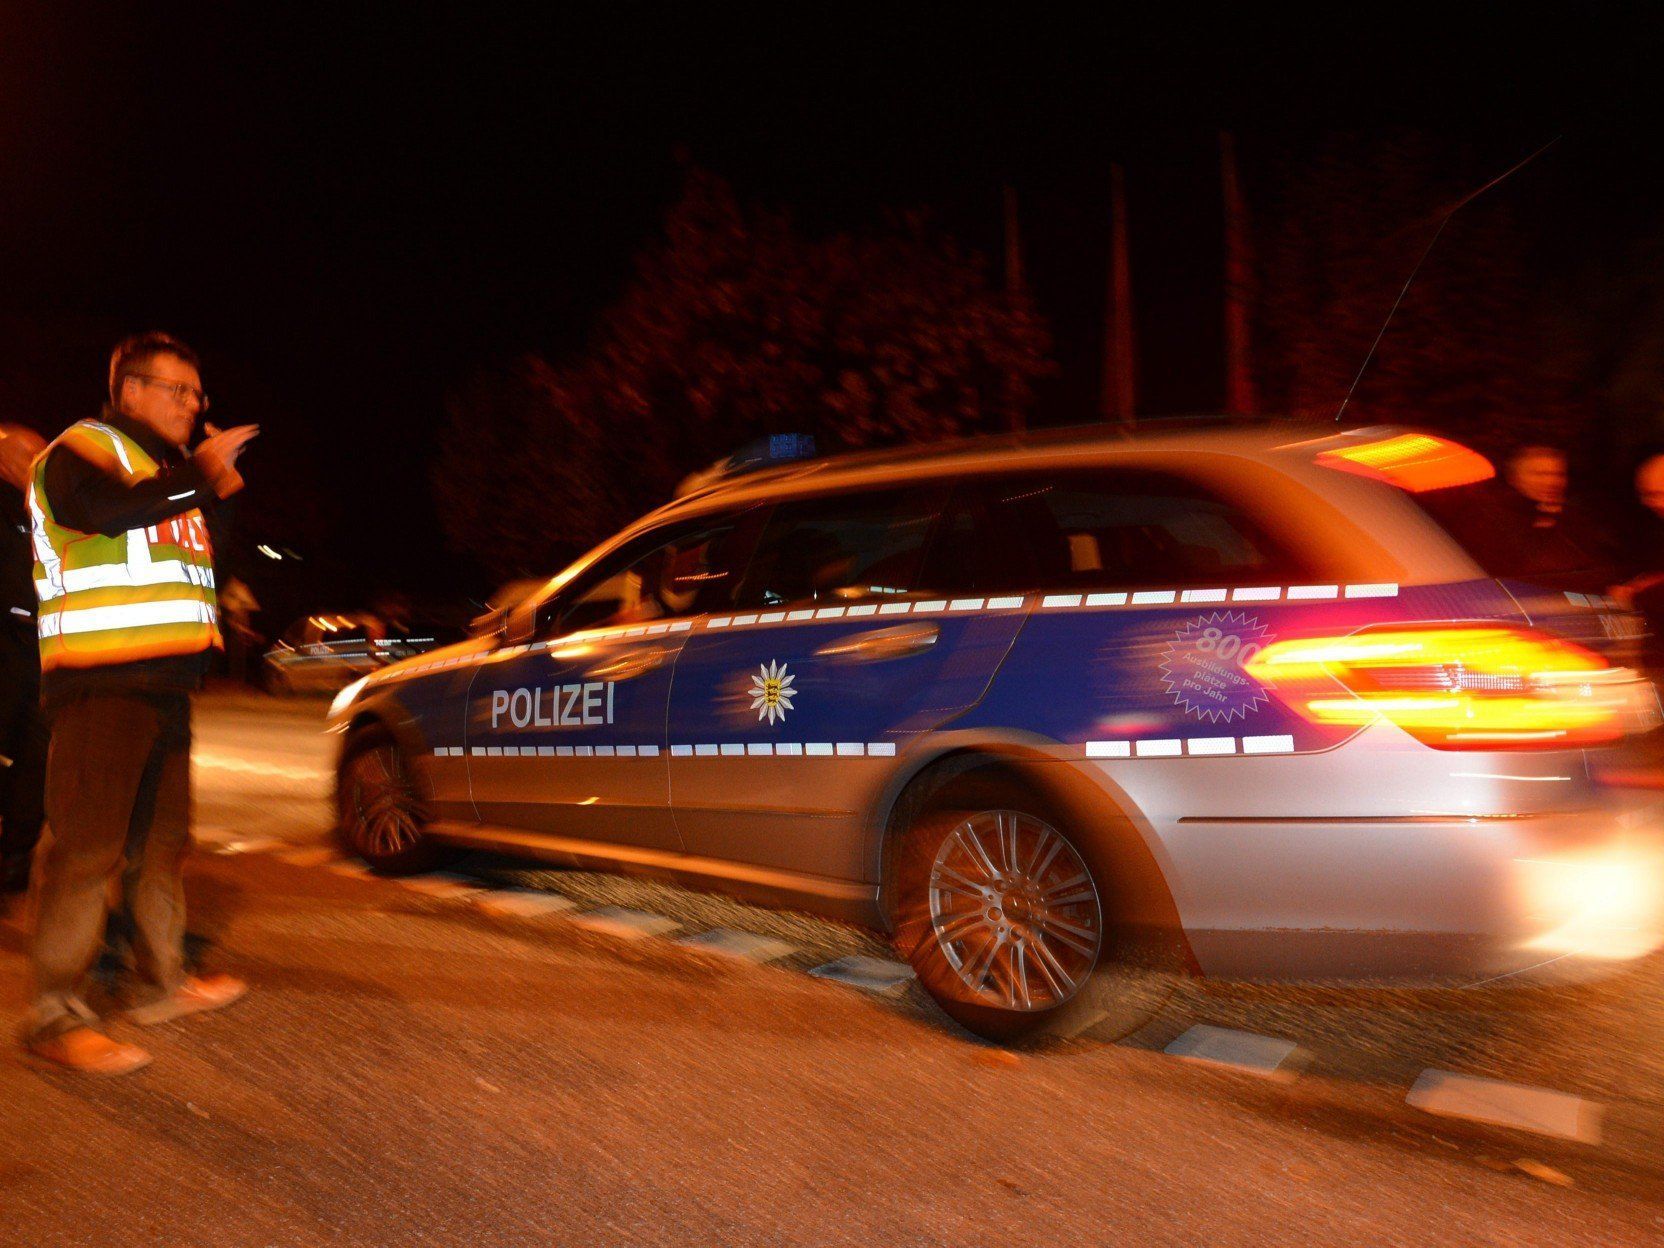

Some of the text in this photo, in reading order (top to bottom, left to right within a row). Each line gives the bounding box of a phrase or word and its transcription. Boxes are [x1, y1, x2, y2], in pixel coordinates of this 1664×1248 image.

[1196, 627, 1262, 667] 800
[1182, 652, 1250, 686] Ausbildungs-
[492, 681, 615, 729] POLIZEI
[1182, 678, 1228, 703] pro Jahr
